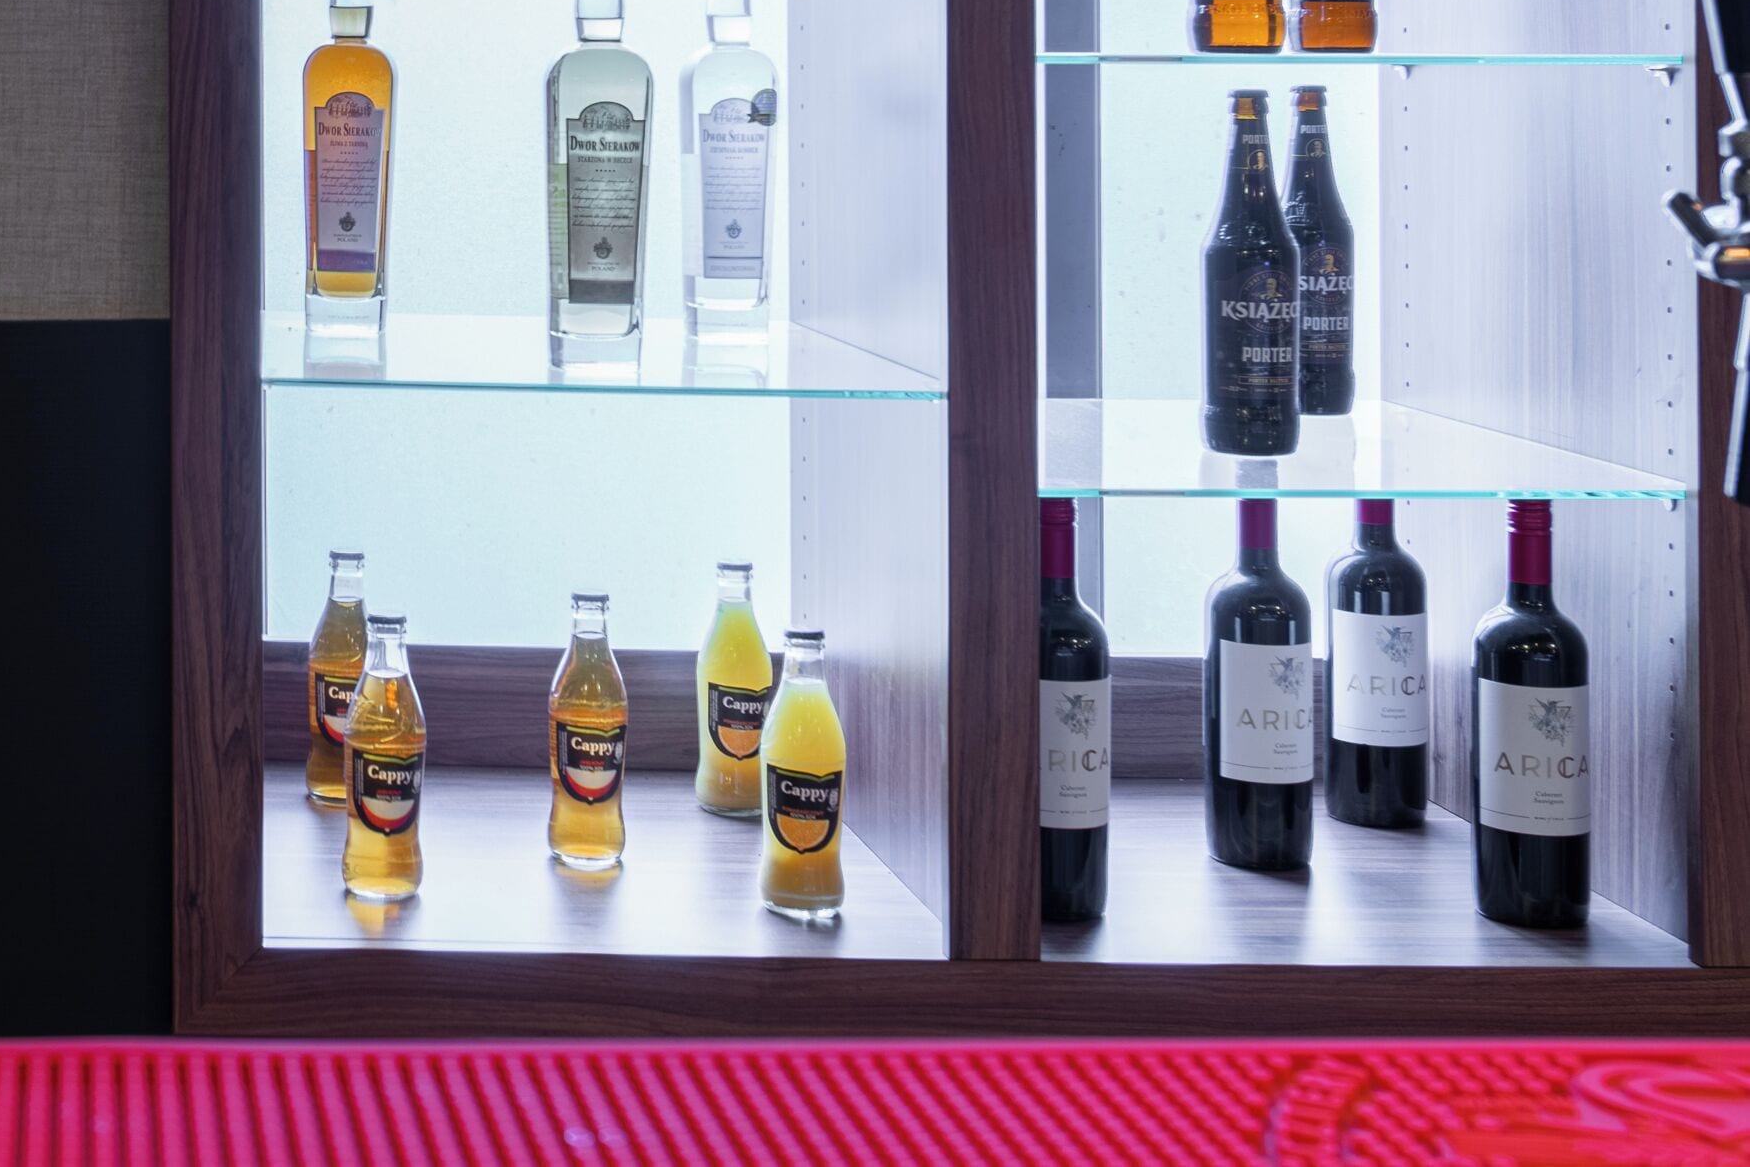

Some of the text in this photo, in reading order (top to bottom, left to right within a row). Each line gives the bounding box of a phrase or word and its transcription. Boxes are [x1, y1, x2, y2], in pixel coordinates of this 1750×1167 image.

[1298, 273, 1354, 295] SIĄŻĘC
[1221, 298, 1298, 322] KSIĄŻĘC
[1303, 316, 1349, 331] PORTER
[1242, 346, 1293, 363] PORTER
[328, 685, 355, 704] Cap
[1346, 674, 1427, 696] ARICA
[722, 695, 763, 714] Cappy
[571, 737, 615, 756] Cappy
[1047, 747, 1109, 772] RICA
[1493, 751, 1589, 779] ARICA
[367, 765, 413, 785] Cappy
[780, 780, 828, 802] Cappy
